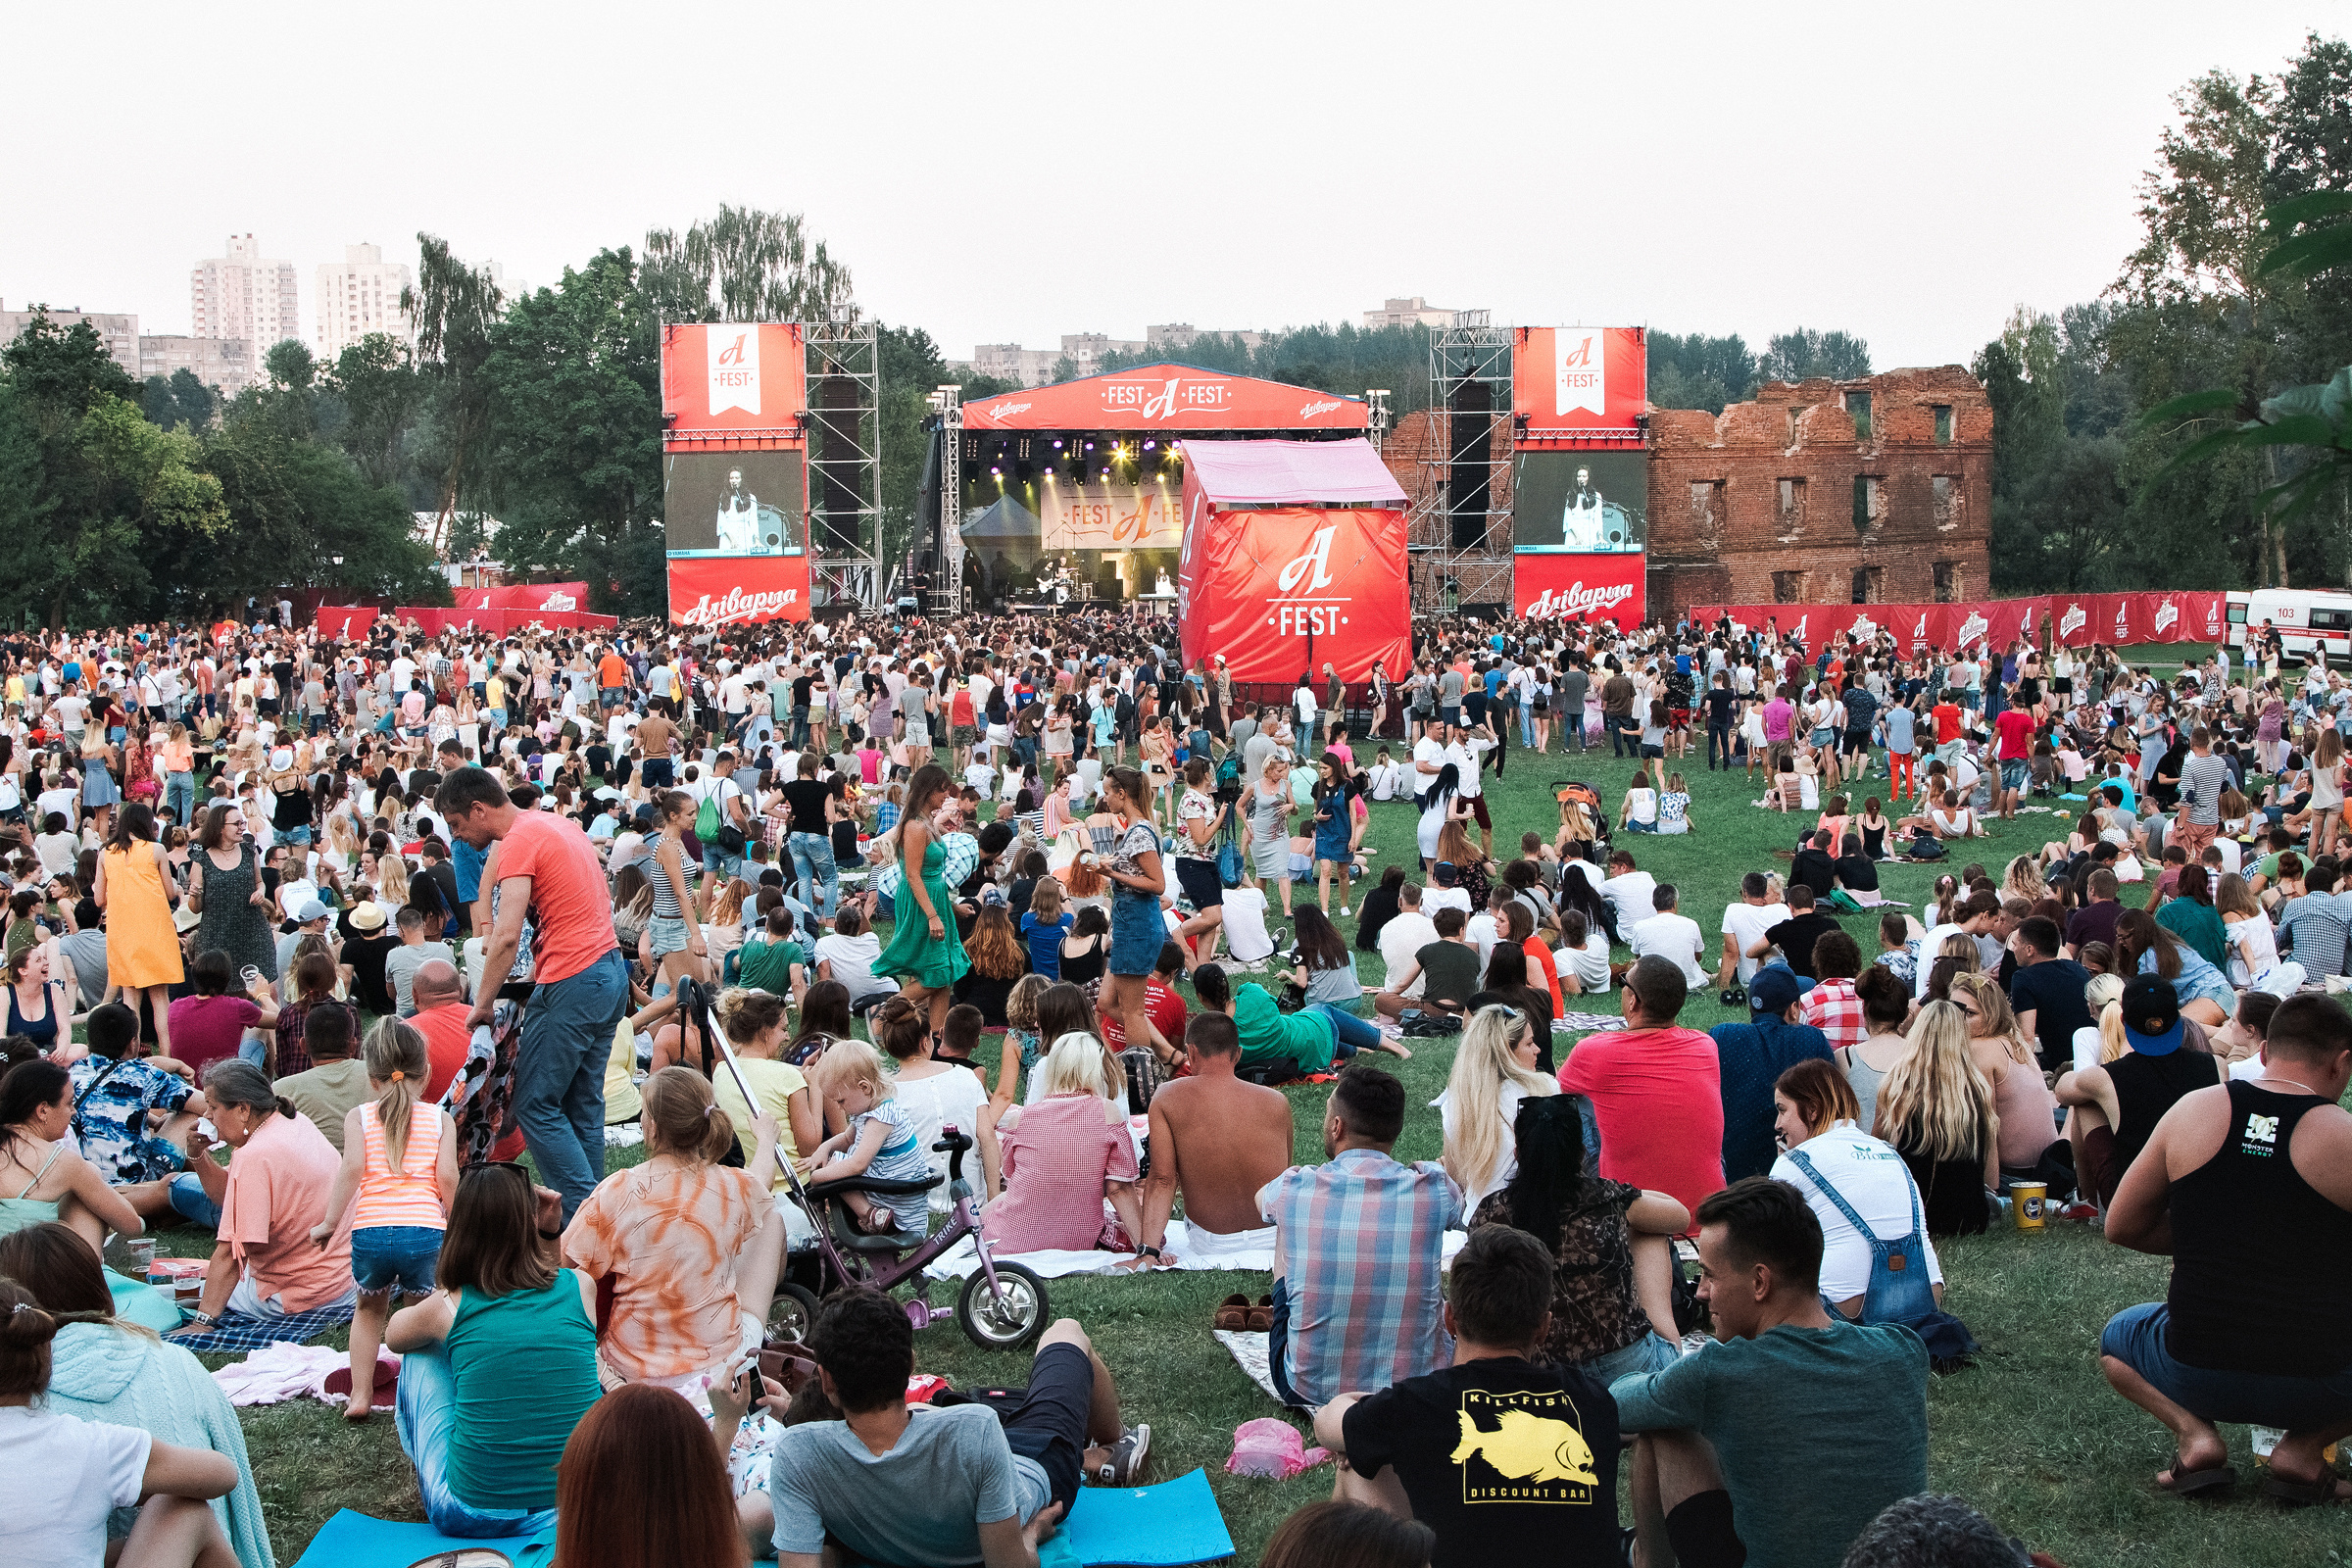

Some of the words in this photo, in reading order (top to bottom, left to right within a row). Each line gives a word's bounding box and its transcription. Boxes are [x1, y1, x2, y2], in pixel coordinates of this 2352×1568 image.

[720, 372, 749, 386] FEST
[1567, 374, 1594, 387] FEST
[1108, 386, 1145, 404] FEST
[1188, 386, 1225, 404] FEST
[1071, 504, 1113, 525] FEST
[1161, 503, 1184, 522] FE
[1278, 524, 1338, 596] A
[2278, 608, 2294, 618] 103
[1280, 606, 1340, 636] FEST
[2241, 1142, 2275, 1153] MONSTER
[2242, 1149, 2273, 1157] ENERGY
[933, 1216, 957, 1246] TRIKE
[1470, 1394, 1568, 1406] KILLFISH
[1471, 1488, 1549, 1497] DISCOUNT
[1560, 1489, 1586, 1498] BAR
